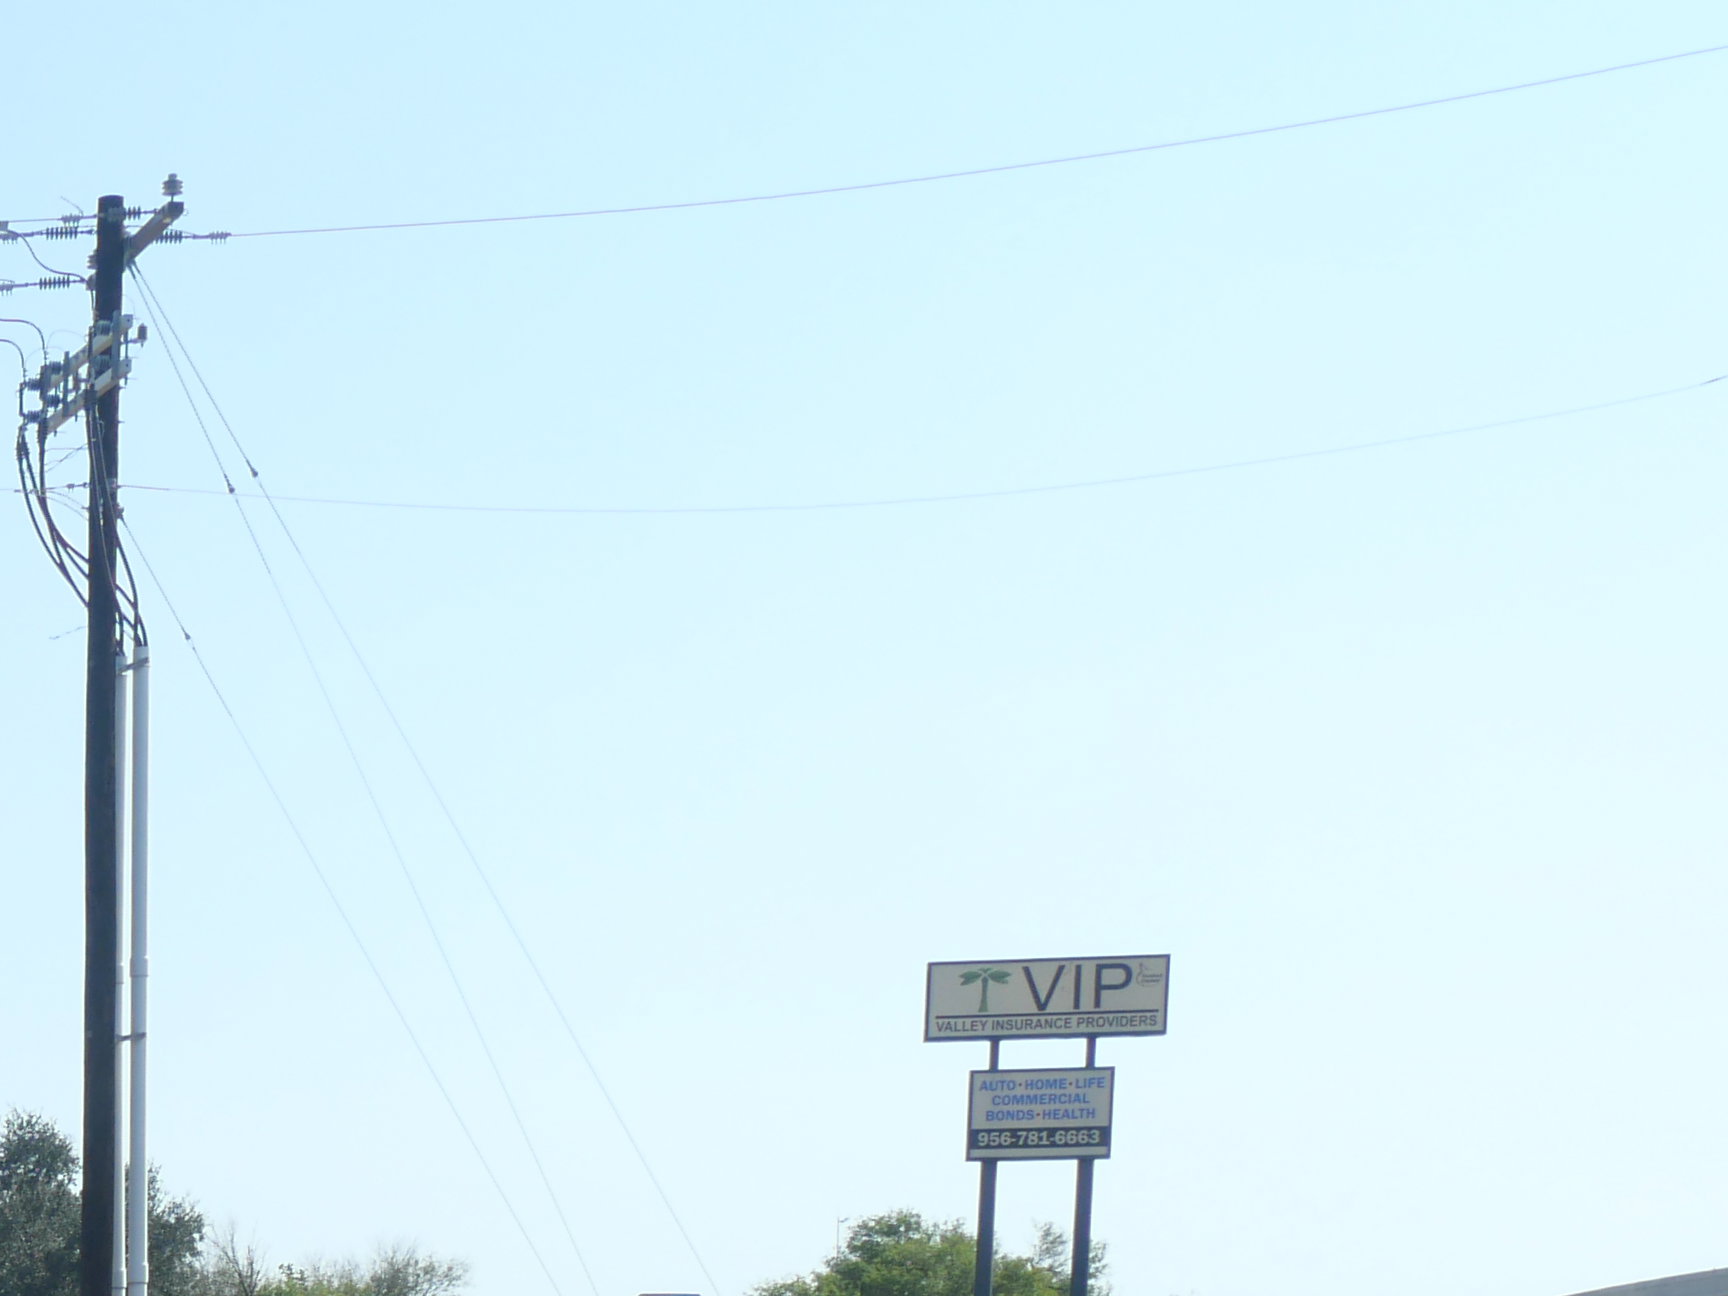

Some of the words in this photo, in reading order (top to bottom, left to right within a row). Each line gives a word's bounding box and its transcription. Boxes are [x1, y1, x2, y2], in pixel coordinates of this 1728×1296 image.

[1022, 963, 1133, 1012] VIP
[936, 1020, 988, 1032] VALLEY
[991, 1017, 1073, 1031] INSURANCE
[1076, 1014, 1158, 1028] PROVIDERS
[979, 1080, 1016, 1091] AUTO
[1025, 1078, 1067, 1090] HOME
[1075, 1077, 1106, 1088] LIFE
[992, 1093, 1091, 1106] COMMERCIAL
[985, 1110, 1035, 1121] BONDS
[1042, 1108, 1096, 1120] HEALTH
[977, 1130, 1101, 1146] 956-781-6663
